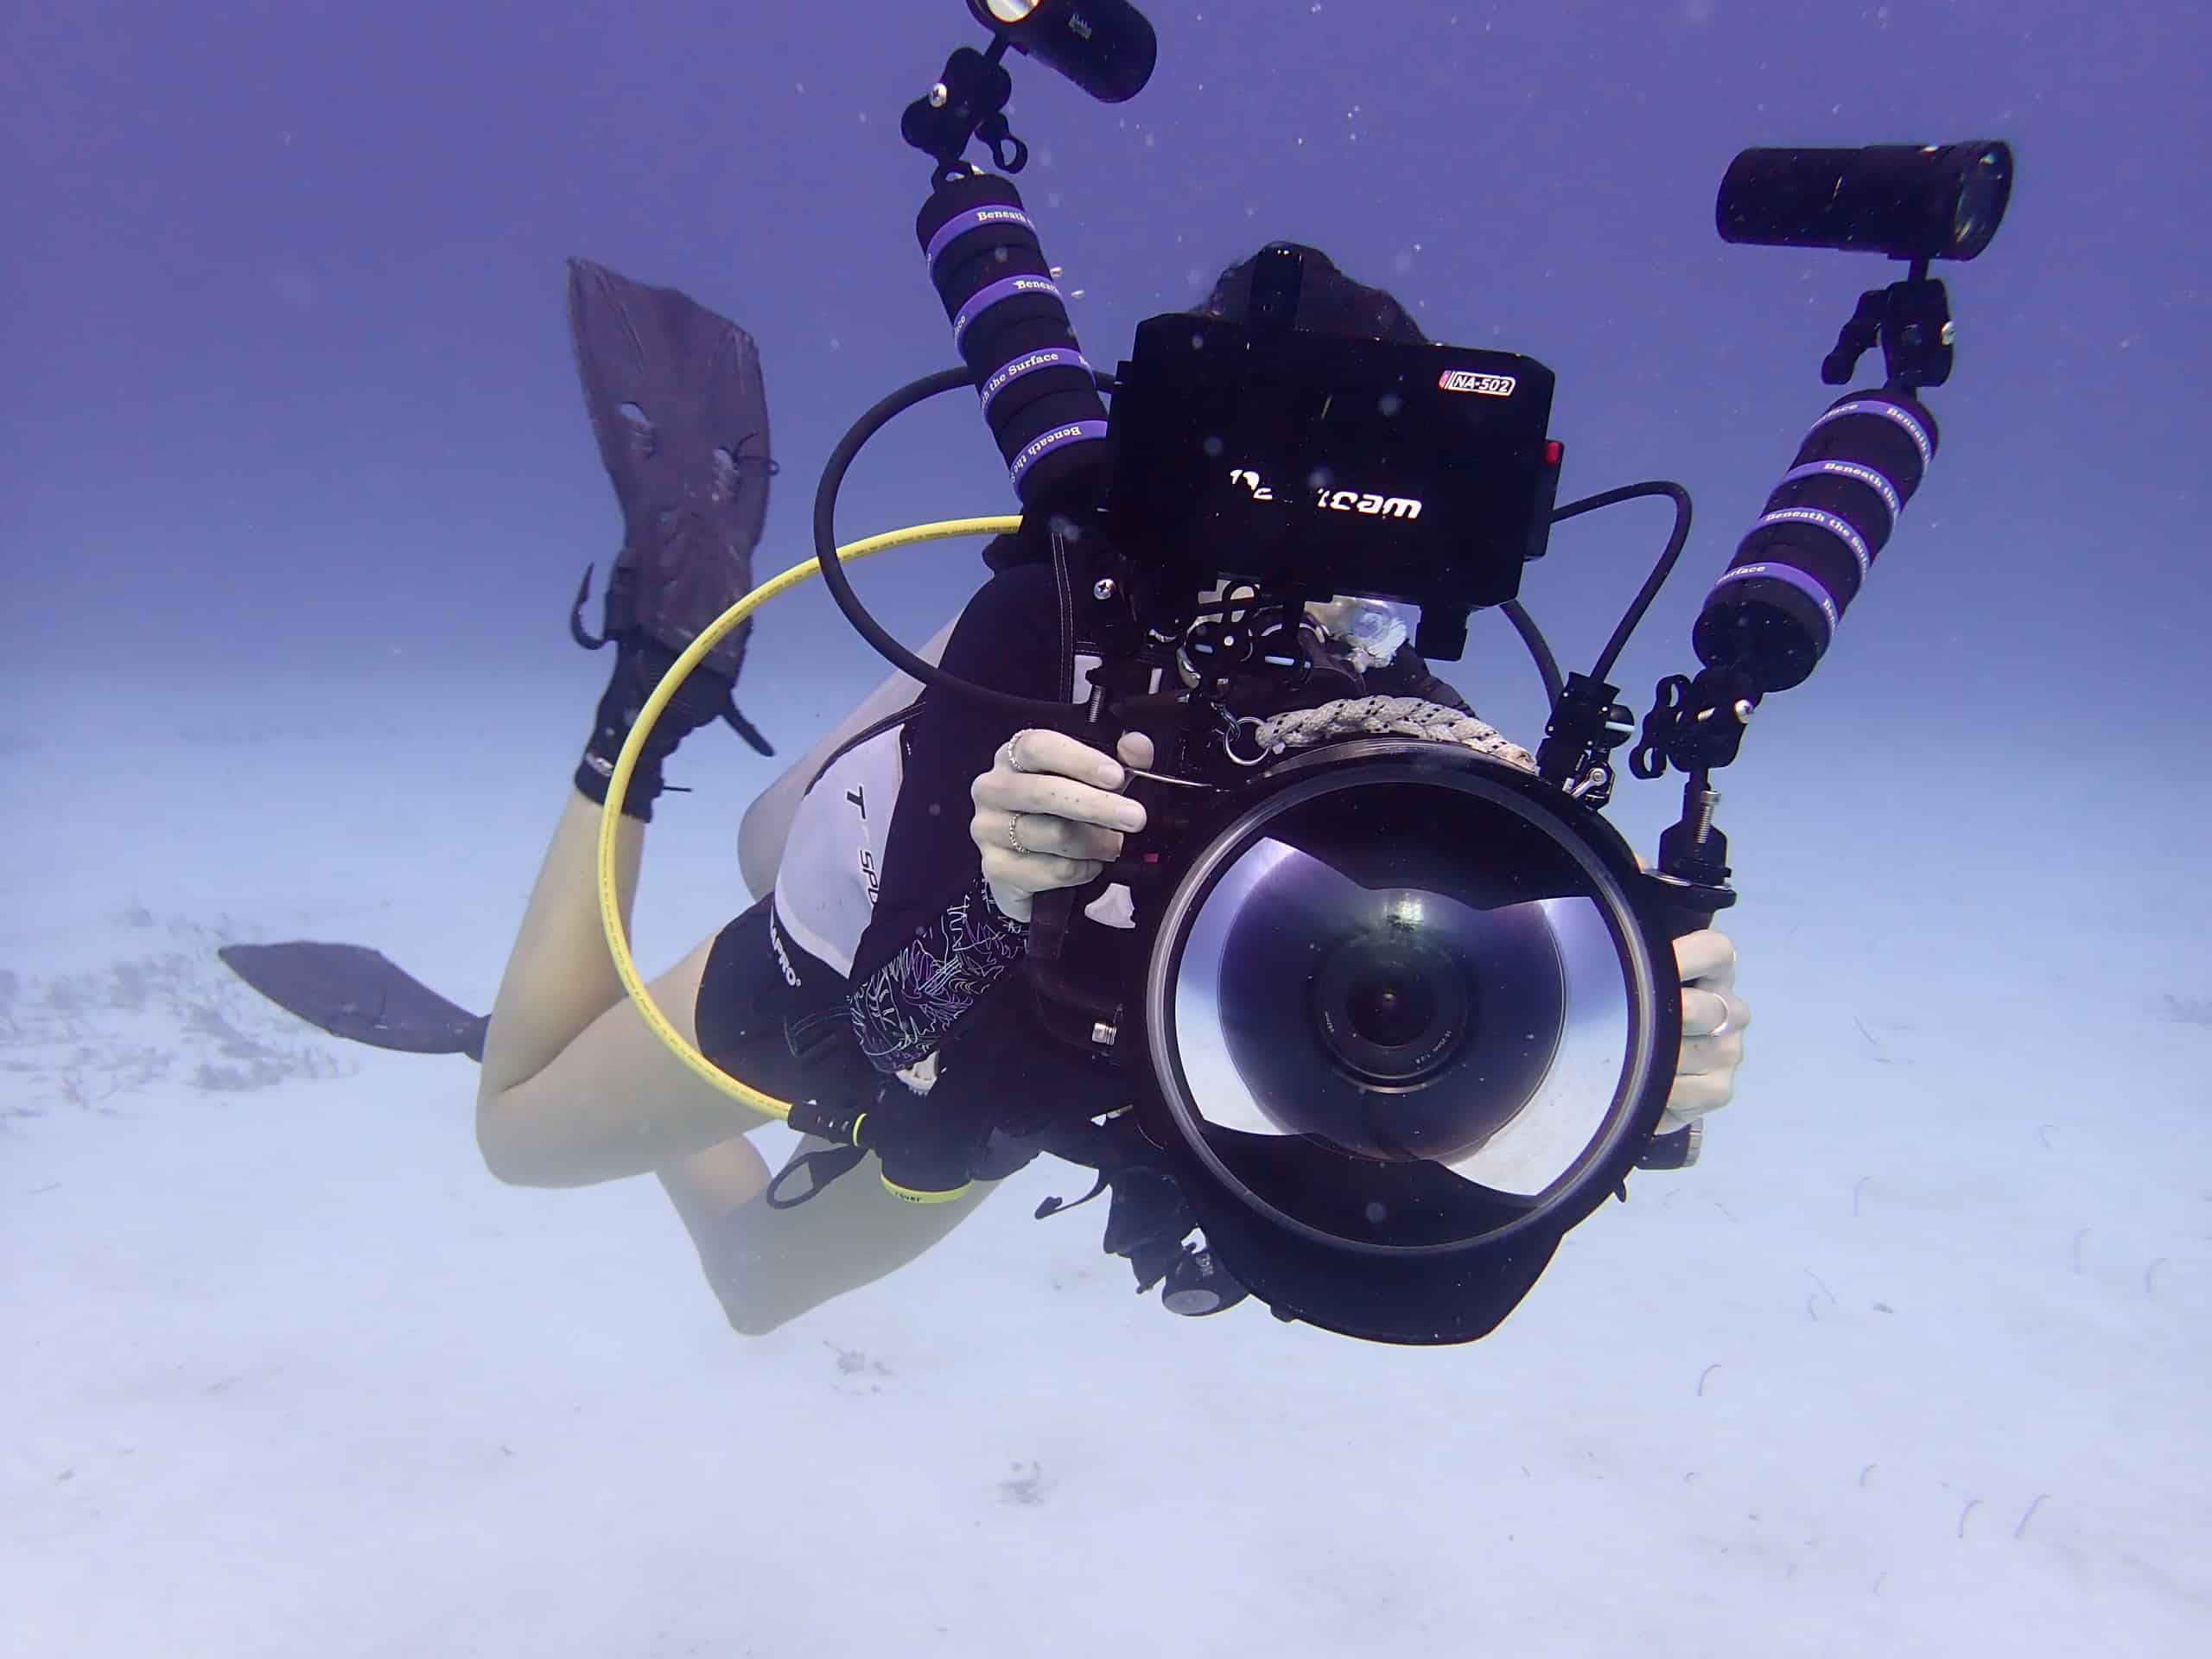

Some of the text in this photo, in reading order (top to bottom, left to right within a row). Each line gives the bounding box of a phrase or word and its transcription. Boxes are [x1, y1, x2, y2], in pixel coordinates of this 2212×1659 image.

[1013, 279, 1058, 294] Benea
[989, 372, 1007, 391] the
[1007, 353, 1059, 376] Surface
[1027, 426, 1083, 456] Beneath
[1824, 462, 1884, 488] Beneath
[1764, 510, 1825, 524] Beneath
[1827, 518, 1851, 537] the
[1715, 565, 1766, 585] rface
